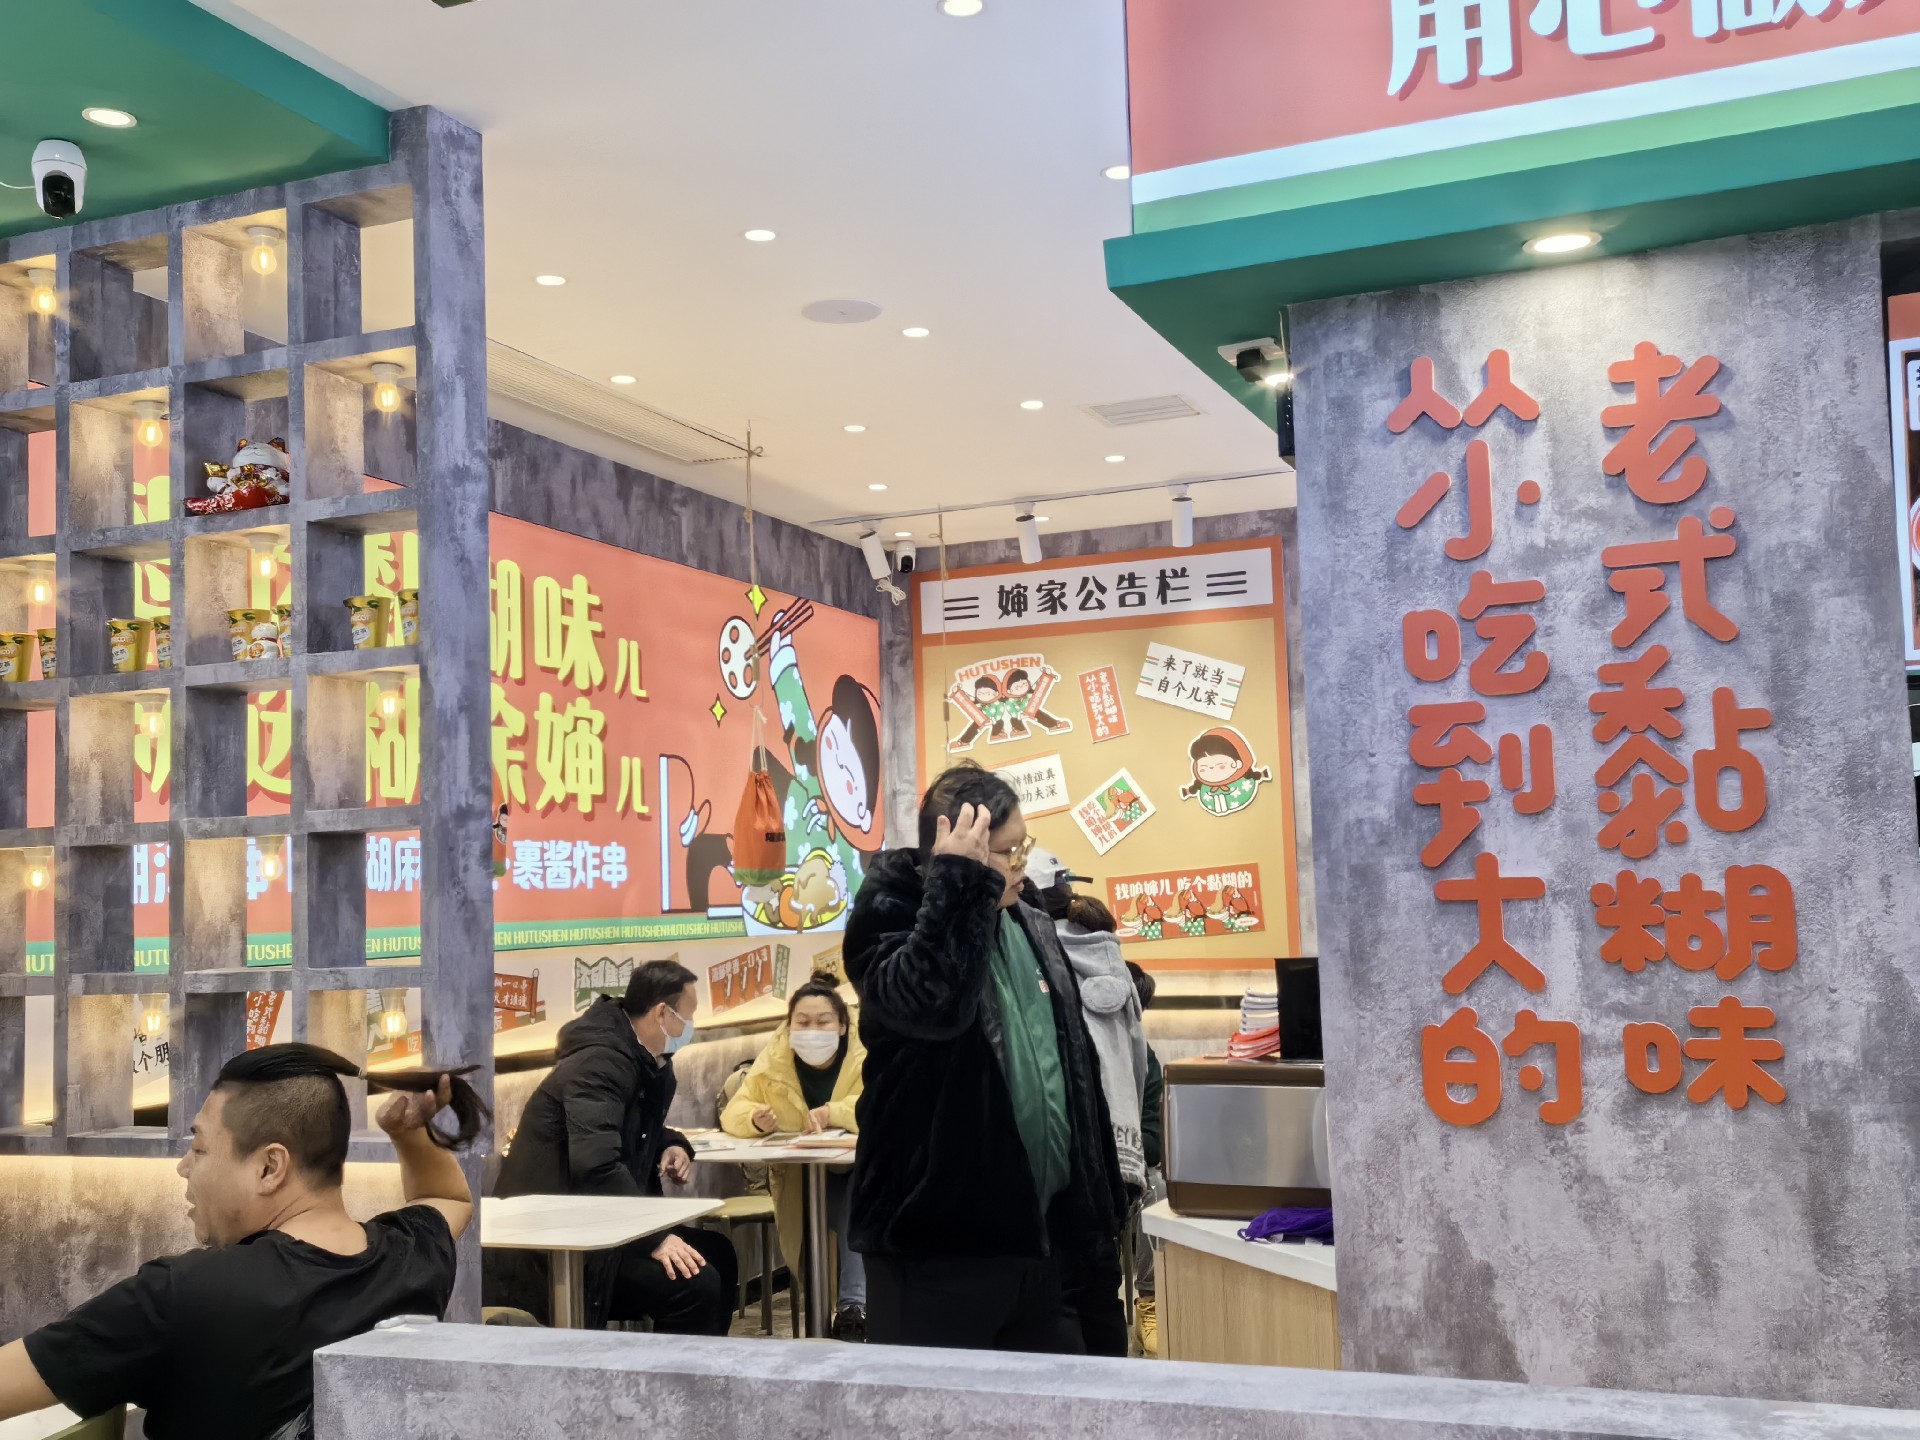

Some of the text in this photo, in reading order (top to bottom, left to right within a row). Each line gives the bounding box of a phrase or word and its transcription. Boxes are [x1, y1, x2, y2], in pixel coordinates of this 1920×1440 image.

[997, 566, 1192, 620] 婶家公告栏
[958, 657, 1041, 682] HUTUSHEN
[1162, 654, 1225, 685] 来了就当
[1158, 676, 1219, 705] 自个儿家
[1387, 349, 1582, 1126] 从小吃到大的
[1589, 341, 1798, 1110] 老式黏糊味
[512, 840, 629, 890] 裹酱炸串
[514, 929, 567, 945] HUTUSHEN
[570, 926, 619, 942] HUTUSHEN
